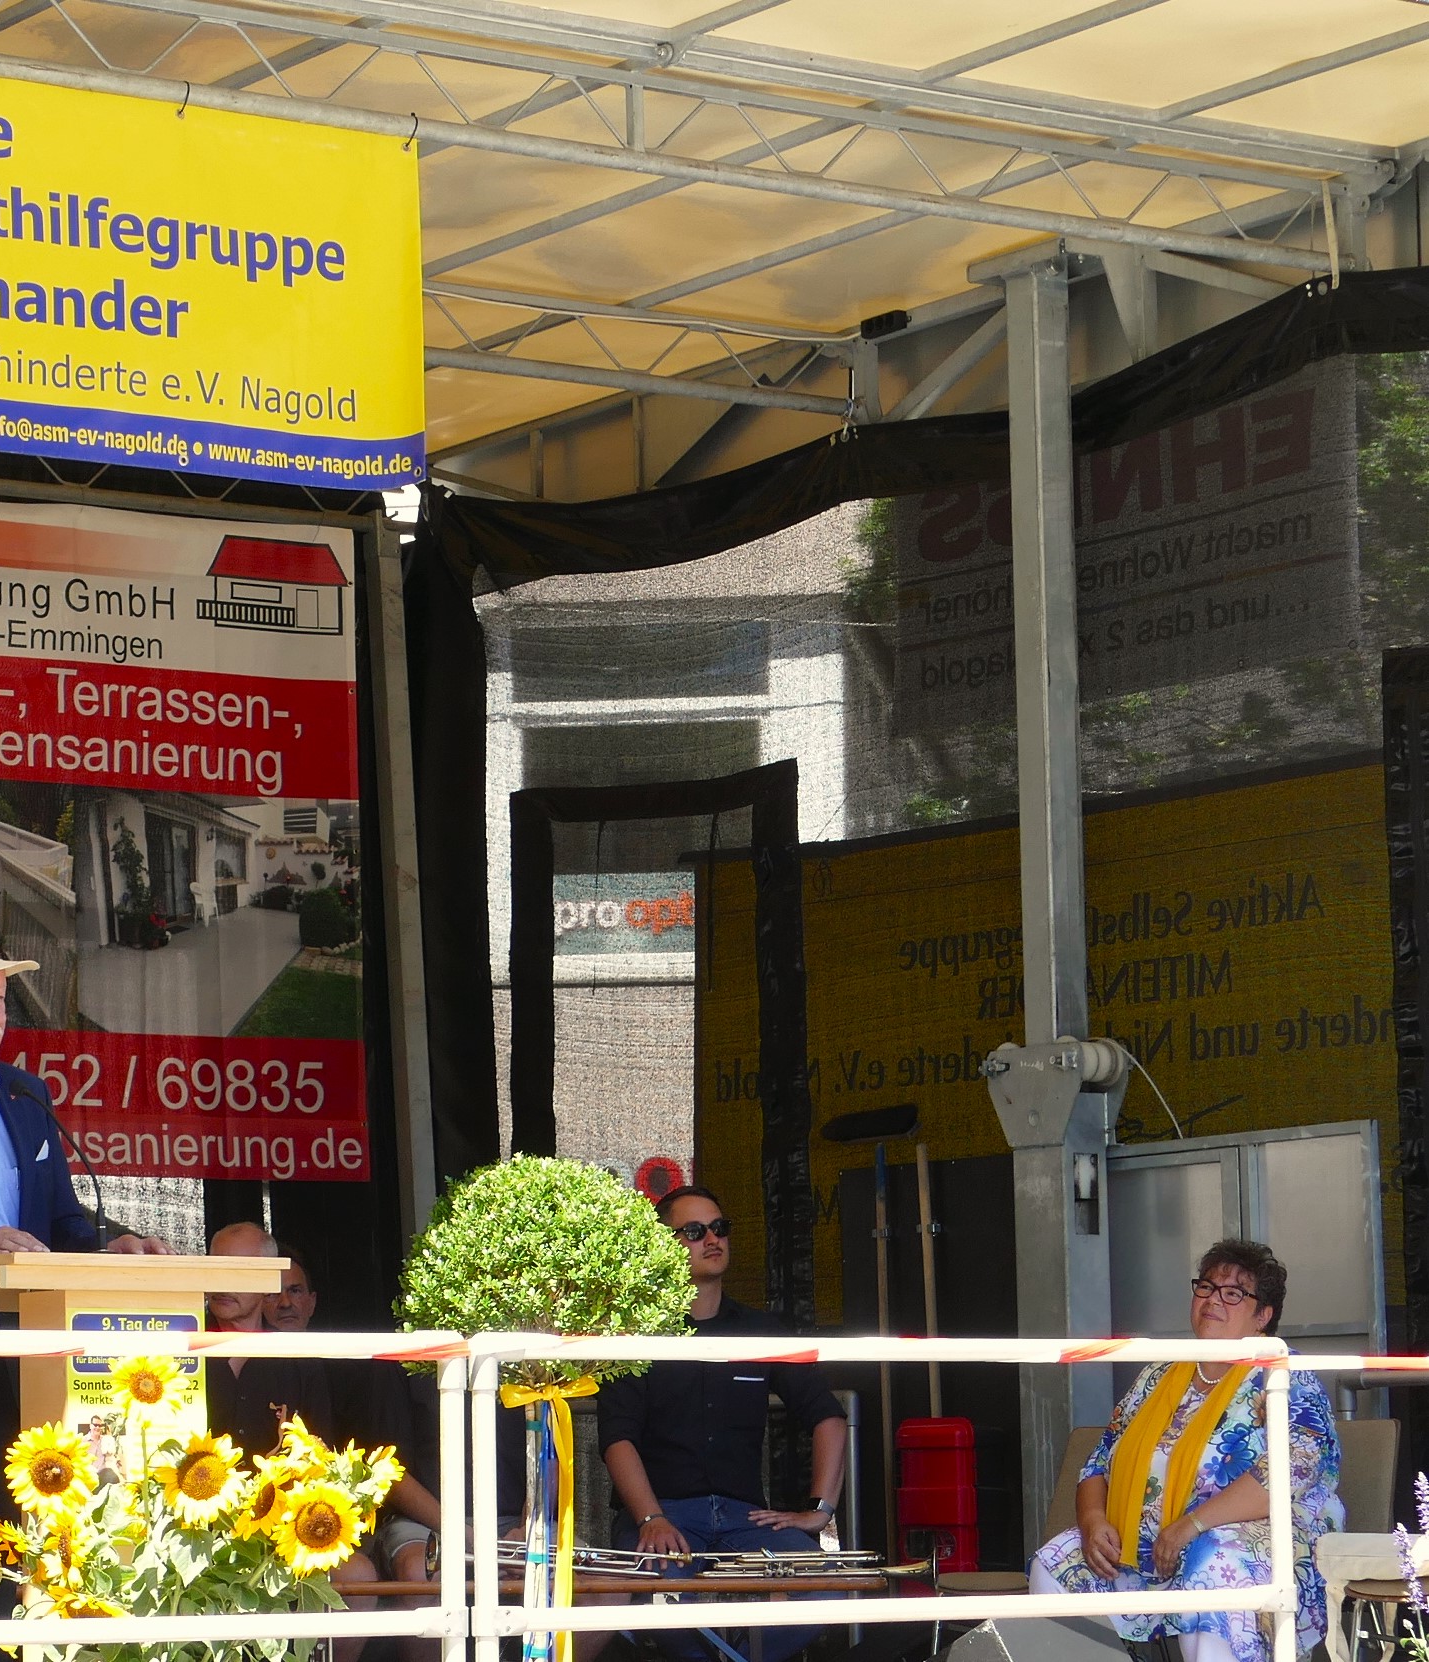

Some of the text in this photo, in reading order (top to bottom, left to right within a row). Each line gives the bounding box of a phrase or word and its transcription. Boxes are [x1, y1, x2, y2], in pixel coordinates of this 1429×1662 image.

[162, 370, 225, 406] e.V.
[240, 375, 357, 425] Nagold
[208, 442, 413, 480] www.asm-ev-nagold.de
[64, 577, 176, 621] GmbH
[46, 667, 304, 739] Terrassen-,
[156, 1058, 326, 1114] 69835
[102, 1317, 115, 1331] 9.
[146, 1317, 169, 1331] der
